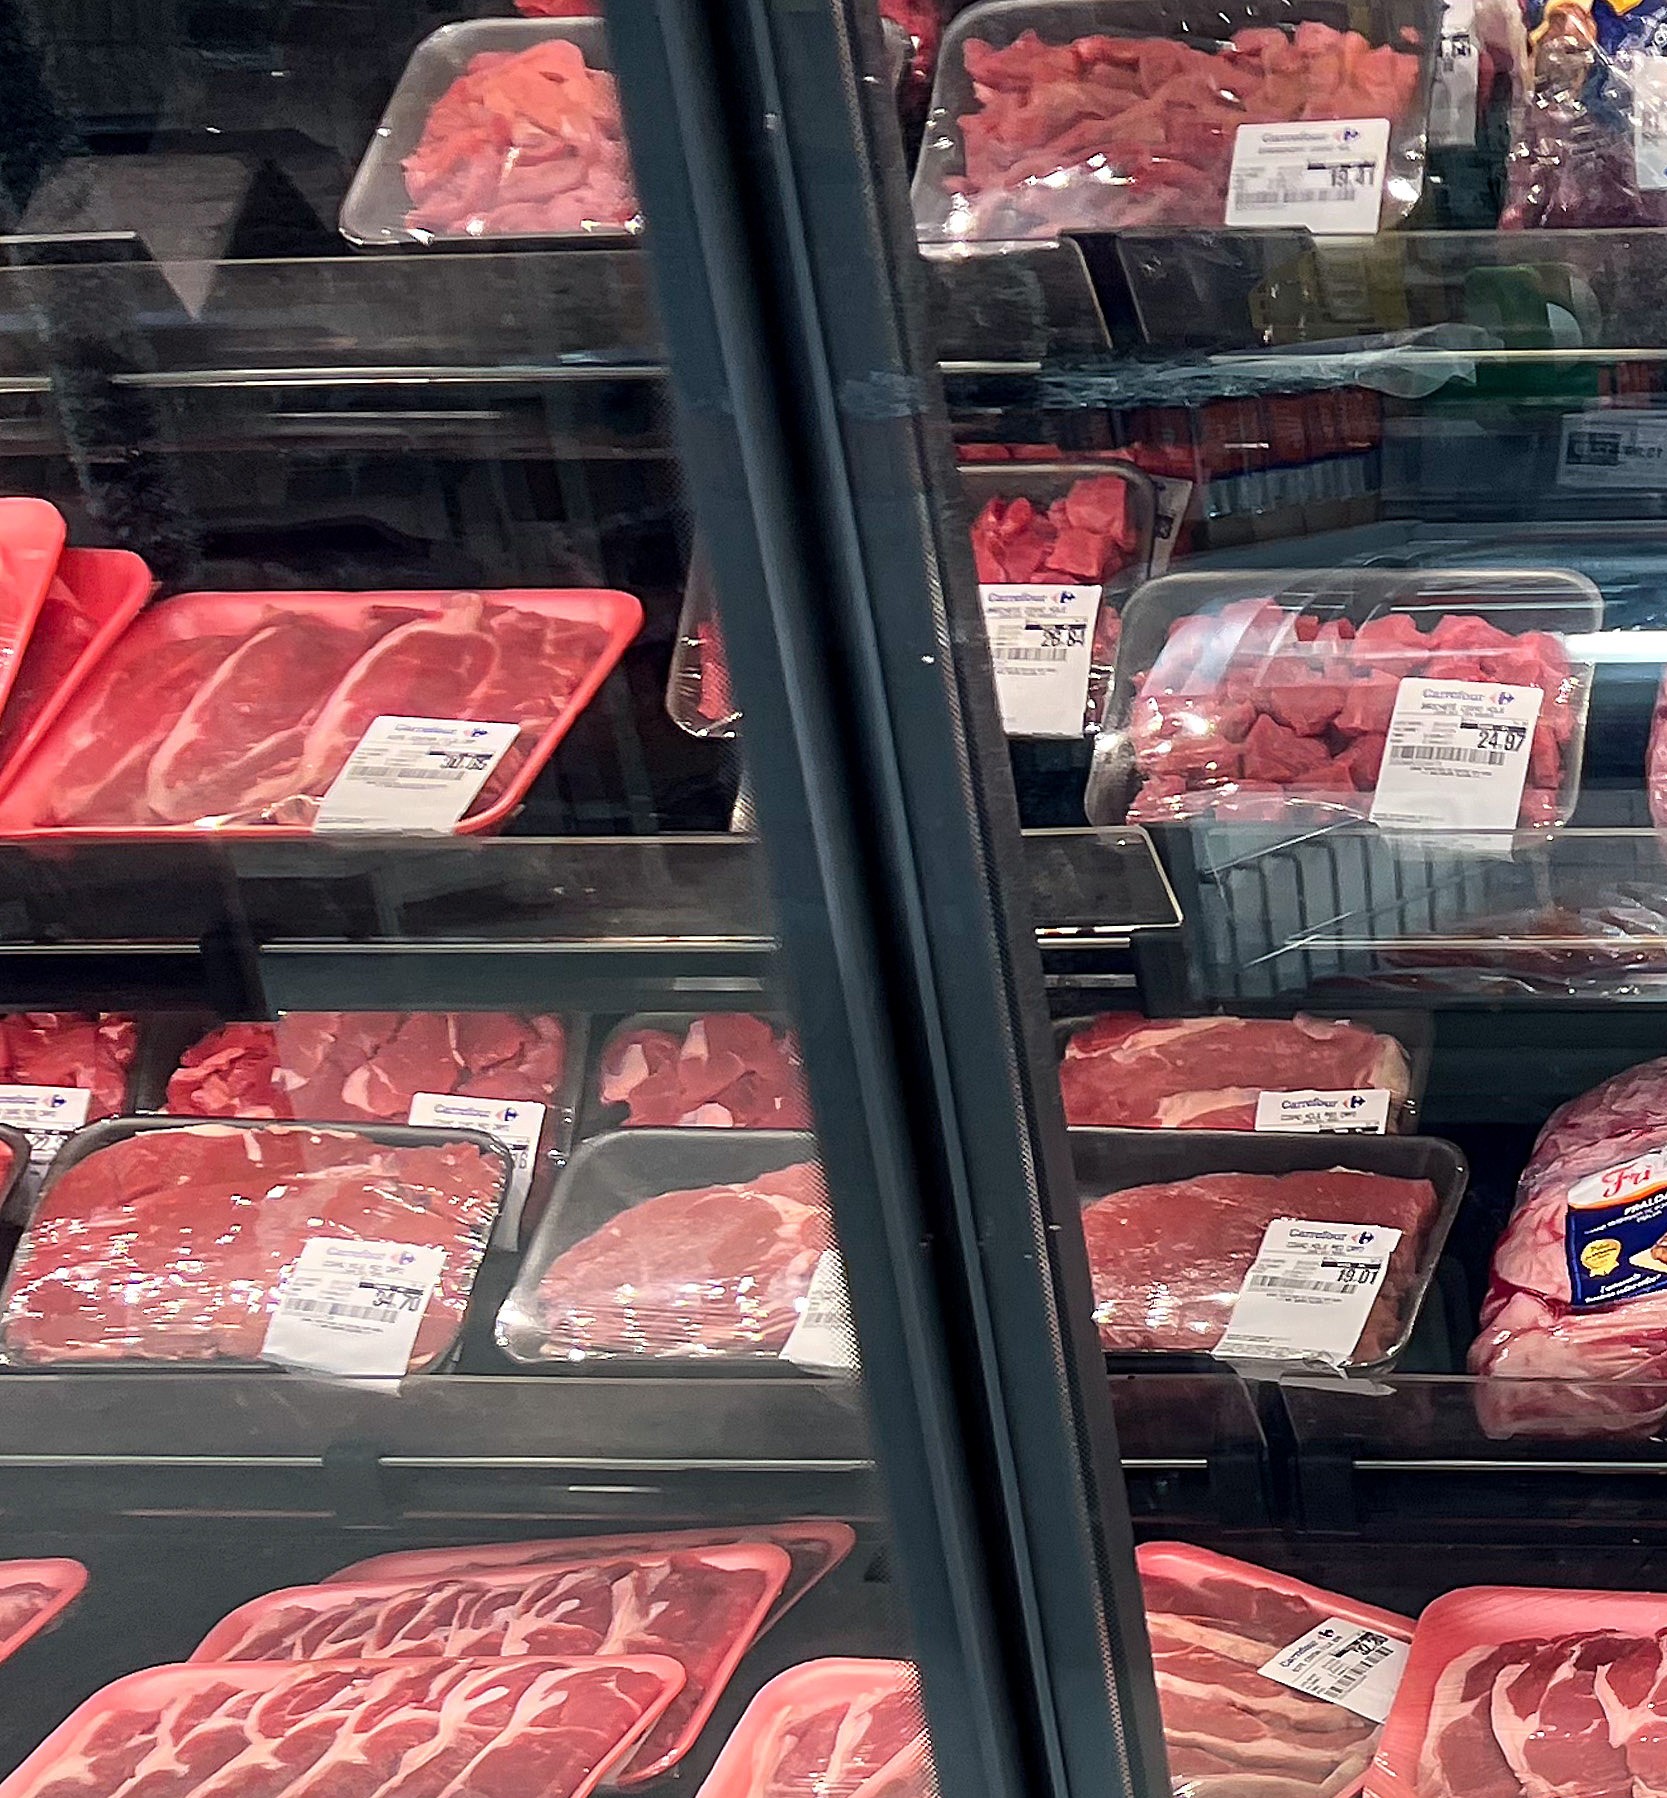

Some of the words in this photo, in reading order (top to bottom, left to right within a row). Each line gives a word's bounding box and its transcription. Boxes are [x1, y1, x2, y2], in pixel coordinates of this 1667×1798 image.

[988, 593, 1046, 603] Carrefour
[1423, 688, 1485, 702] Carrefour
[1477, 731, 1526, 751] 24.97
[1281, 1098, 1338, 1110] Carrefour
[1289, 1227, 1348, 1242] Carrefour
[1336, 1267, 1377, 1286] 19.01
